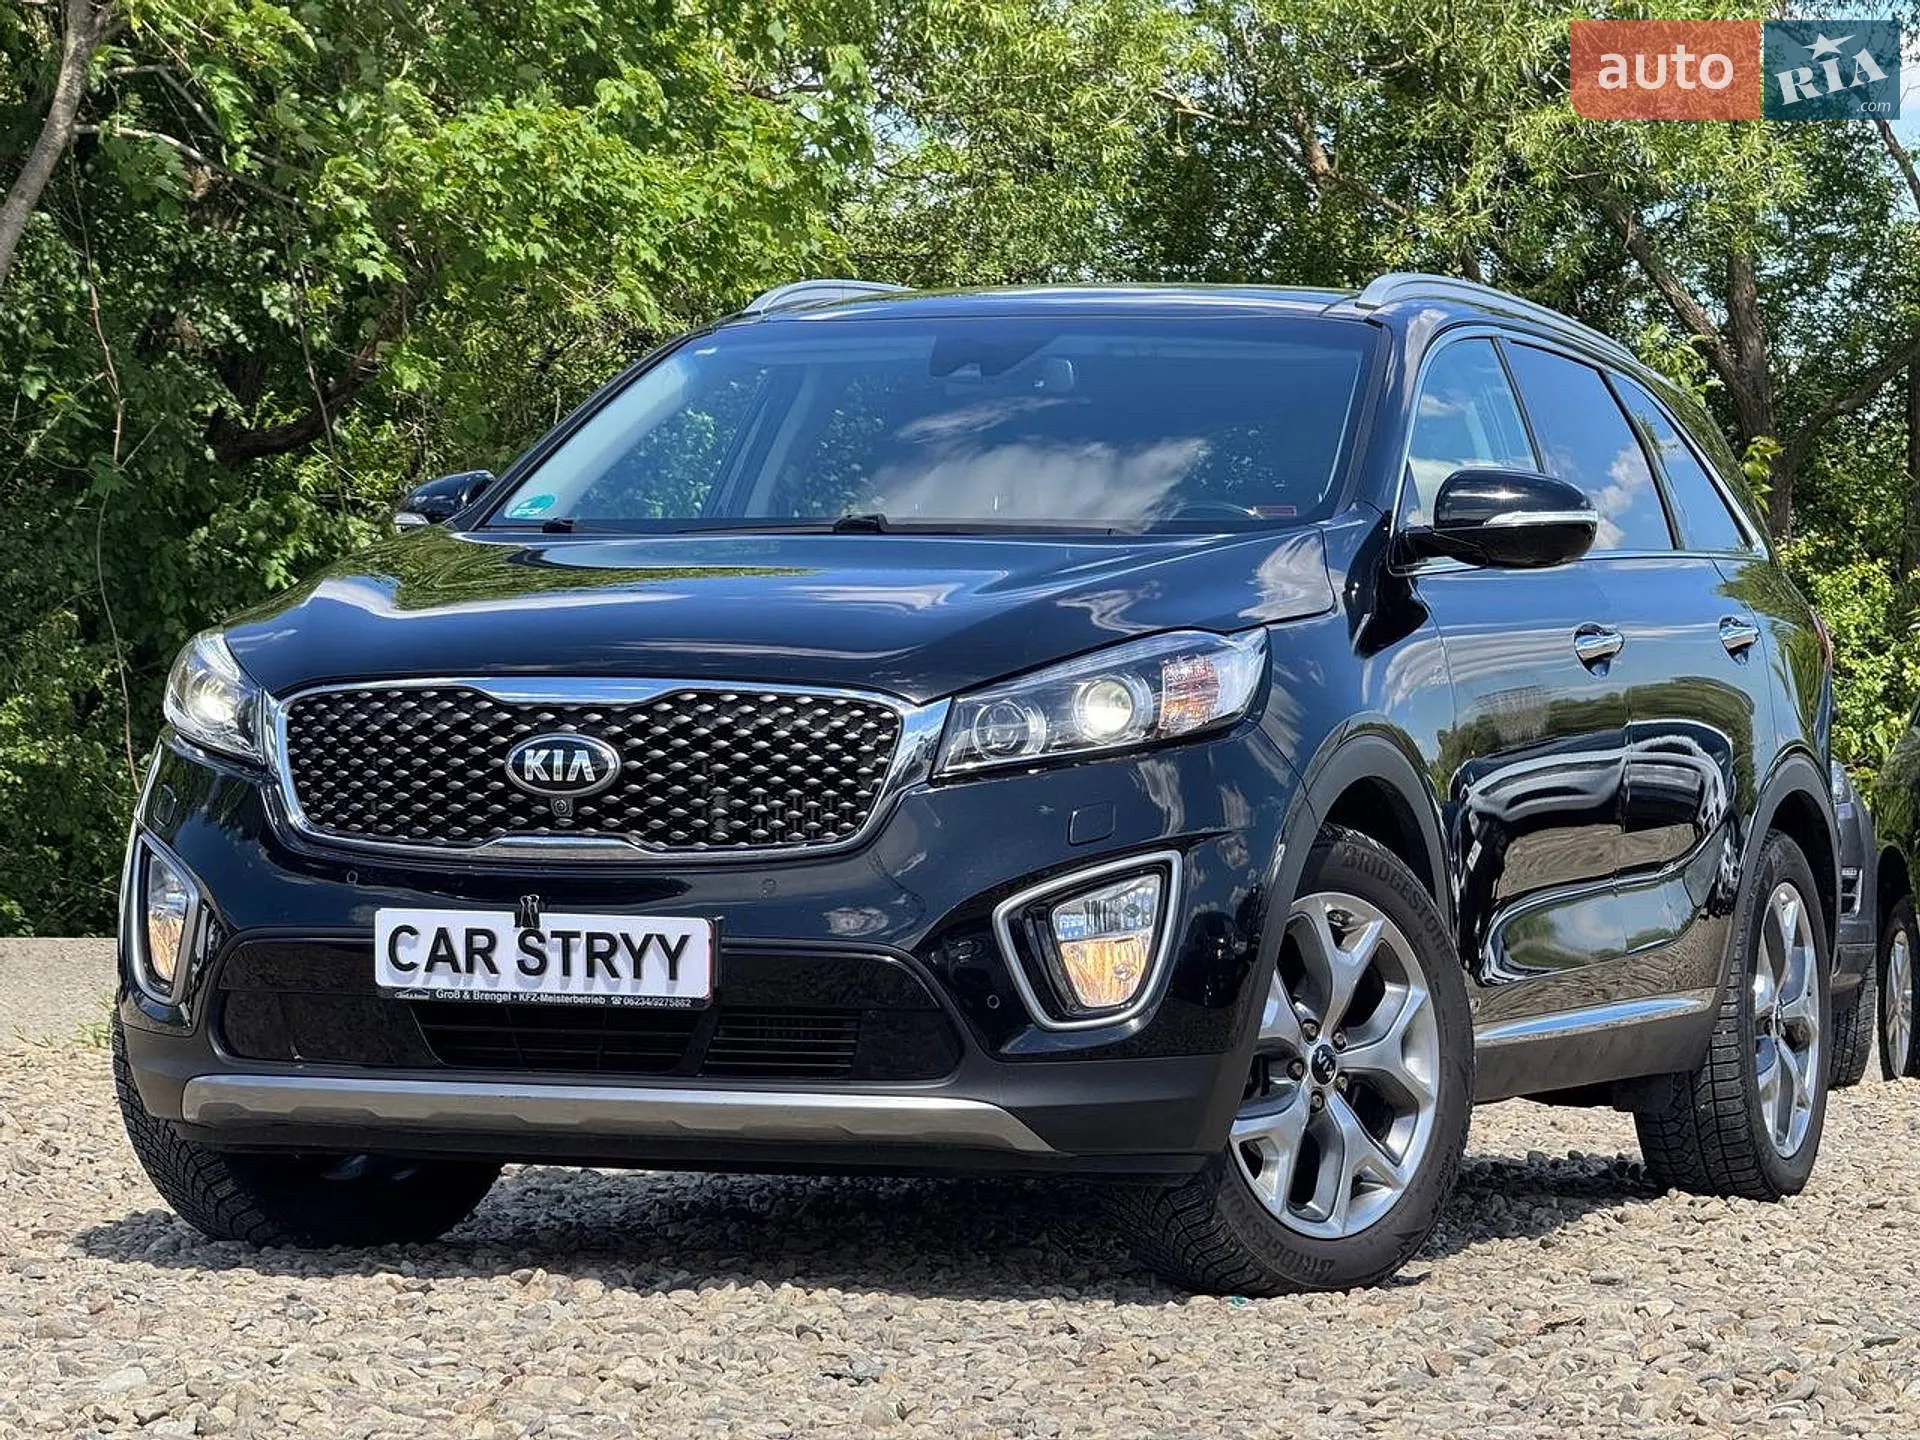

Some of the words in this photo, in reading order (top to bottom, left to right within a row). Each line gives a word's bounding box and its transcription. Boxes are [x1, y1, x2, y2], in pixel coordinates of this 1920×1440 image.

[523, 748, 596, 782] KIA
[387, 924, 500, 976] CAR
[516, 928, 691, 981] STRYY
[463, 989, 471, 1000] &
[473, 989, 511, 1003] Brengel
